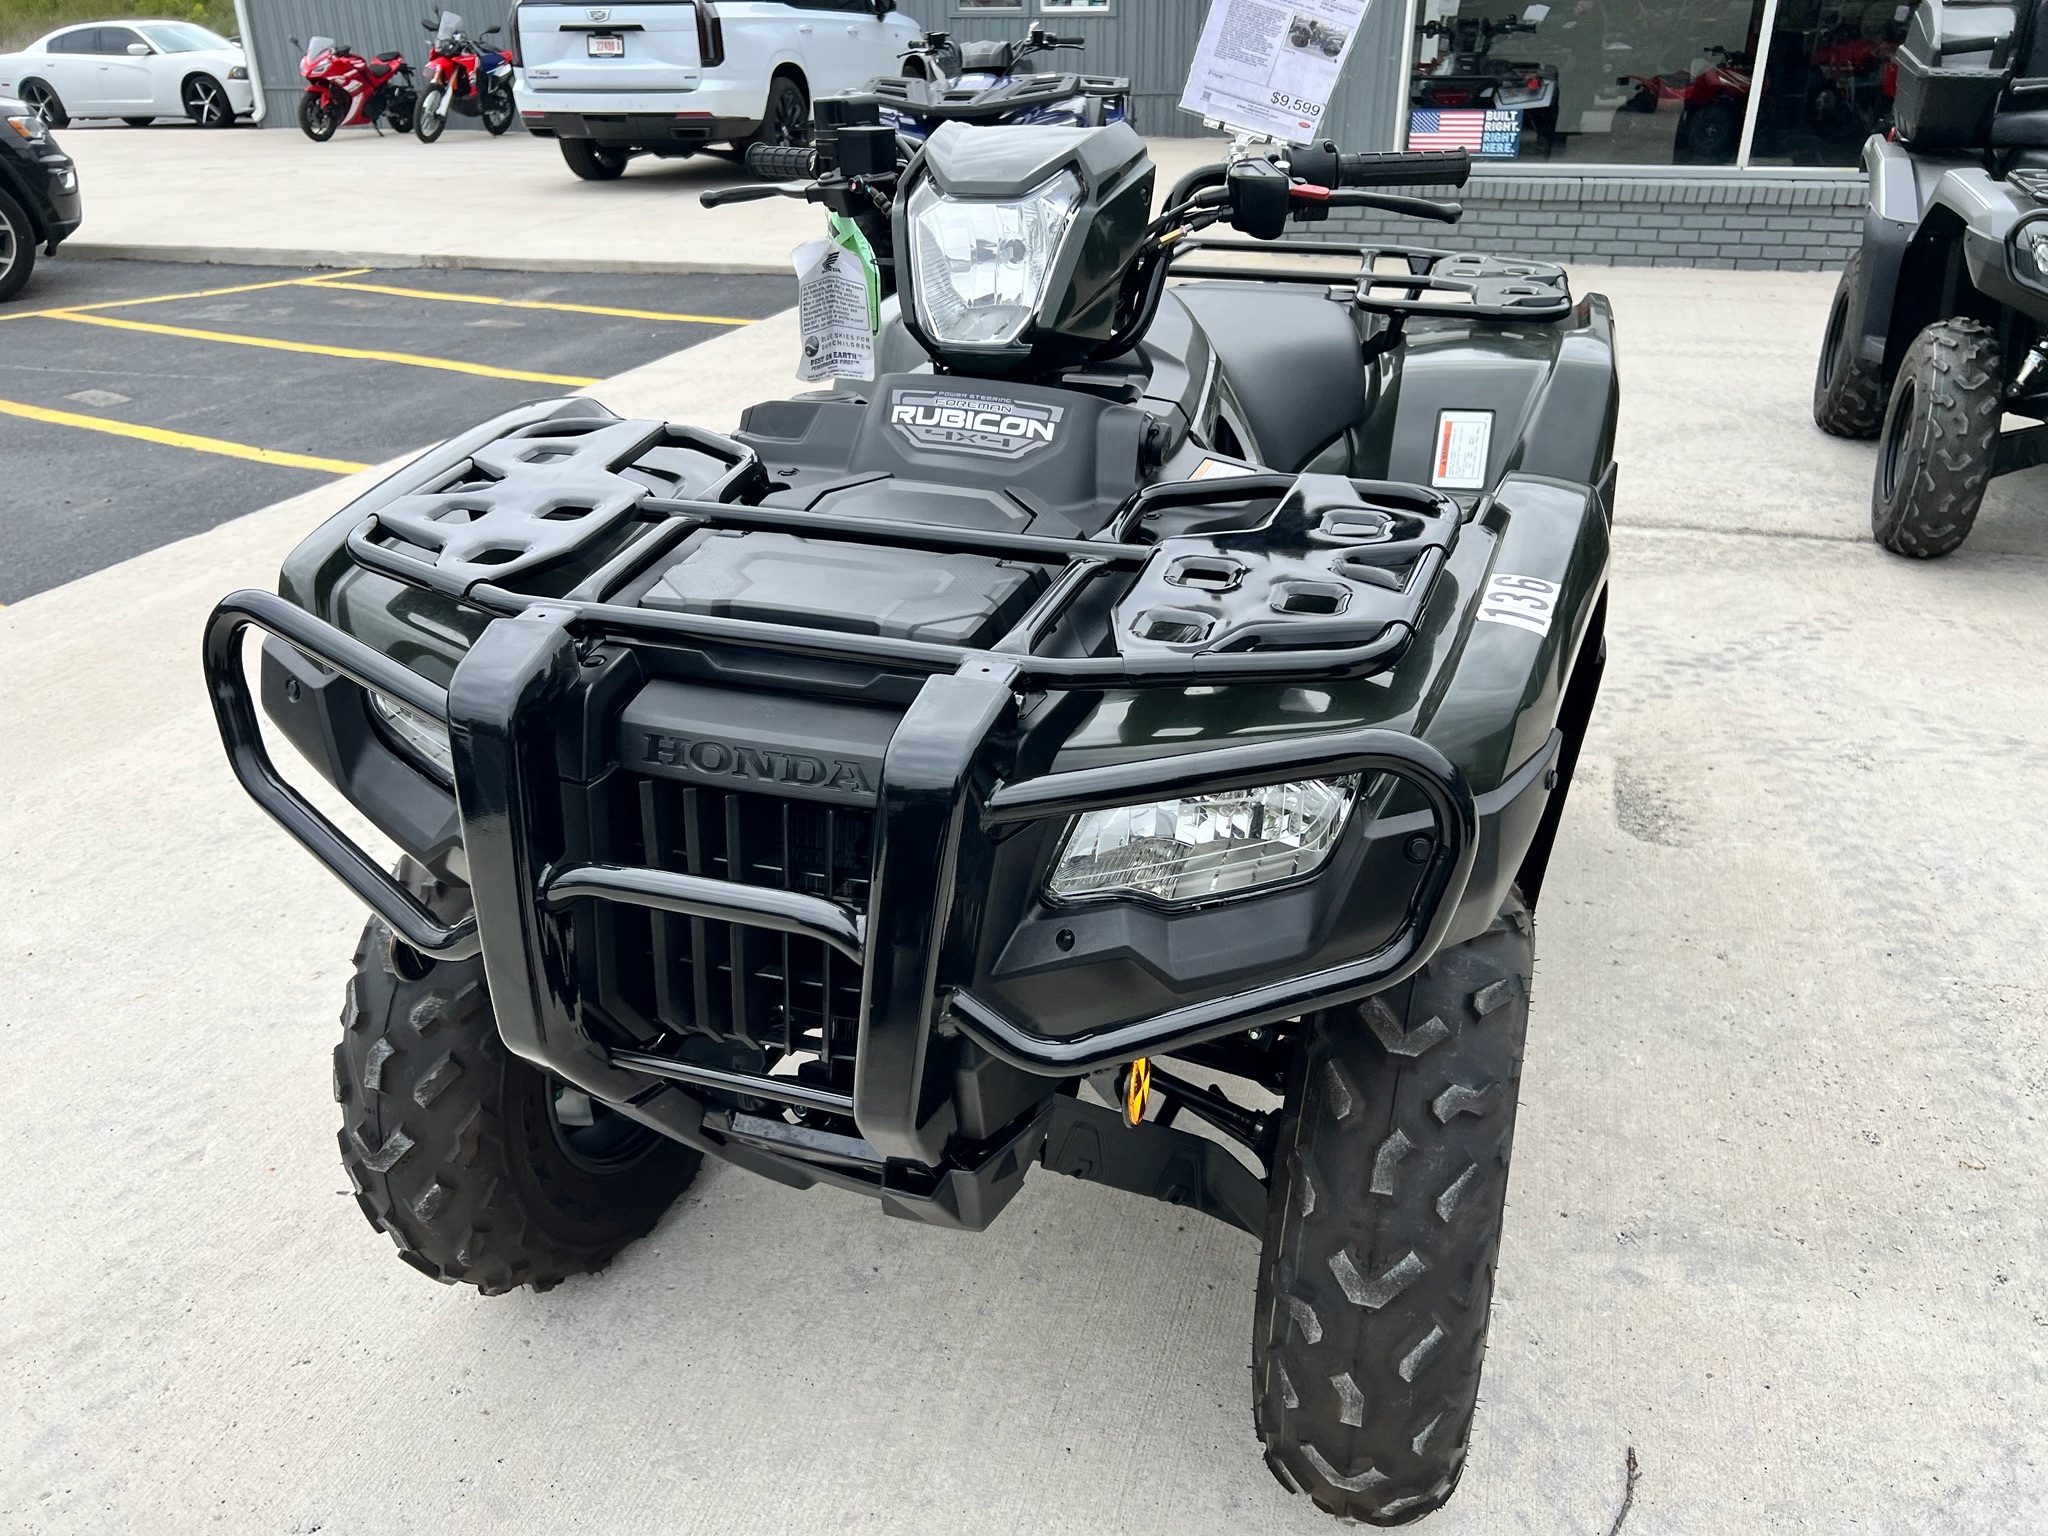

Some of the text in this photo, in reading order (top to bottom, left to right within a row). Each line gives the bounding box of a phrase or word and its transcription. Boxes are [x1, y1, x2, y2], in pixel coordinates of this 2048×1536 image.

[1270, 91, 1321, 116] $9,599
[1485, 110, 1518, 122] BUILT
[1484, 121, 1520, 132] RIGHT.
[1482, 132, 1518, 143] RIGHT
[1481, 142, 1515, 153] HERE.
[821, 332, 870, 343] BLUE SKIES FOR
[832, 340, 871, 350] CHILDREN
[810, 355, 825, 366] BEST
[938, 391, 1012, 403] POWER STEERING
[934, 398, 1012, 415] FOREMAN
[891, 405, 1056, 442] RUBICON
[1483, 576, 1554, 626] 136
[641, 733, 877, 796] HONDA
